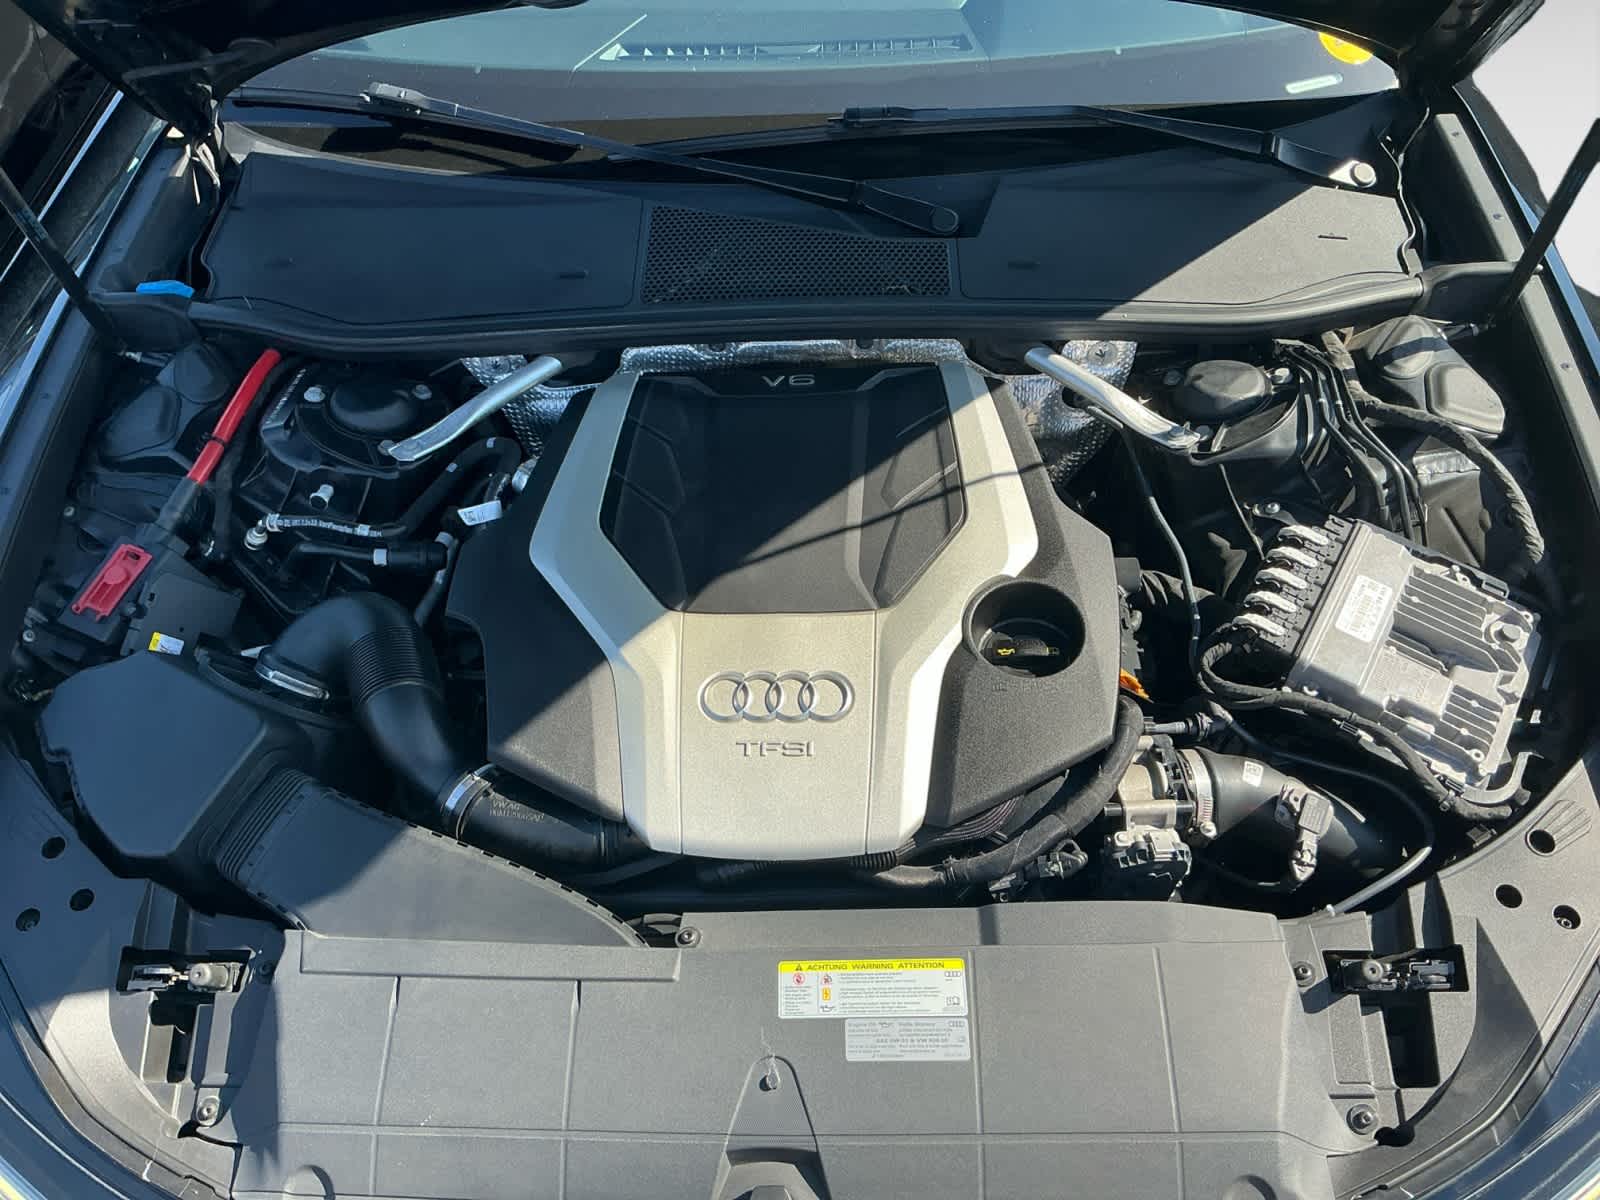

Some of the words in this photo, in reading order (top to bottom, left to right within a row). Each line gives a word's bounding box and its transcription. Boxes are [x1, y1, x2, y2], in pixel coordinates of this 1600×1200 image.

[761, 374, 815, 387] V6
[735, 741, 815, 757] TFSI
[807, 963, 848, 971] ACHTUNG
[851, 962, 894, 970] WARNING
[897, 961, 945, 969] ATTENTION
